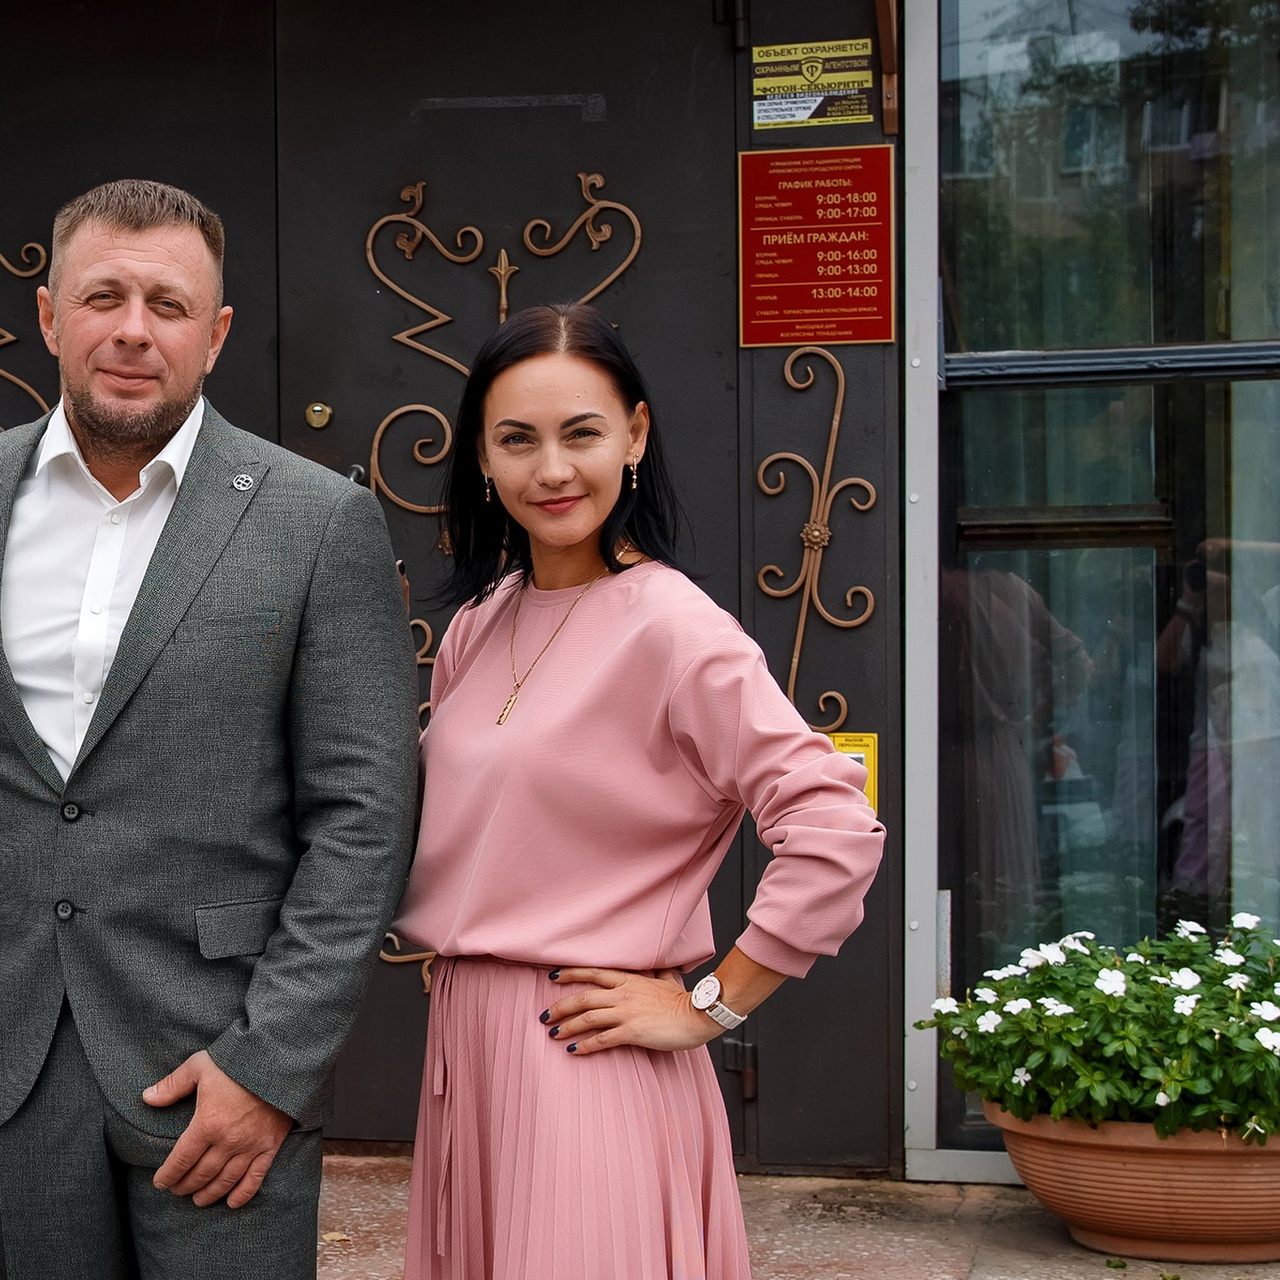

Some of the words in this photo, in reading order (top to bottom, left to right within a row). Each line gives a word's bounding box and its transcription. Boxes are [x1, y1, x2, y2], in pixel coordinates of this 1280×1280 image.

[757, 48, 798, 58] ОБЪЕКТ
[801, 42, 869, 55] ОХРАНЯЕТСЯ
[755, 64, 800, 75] ОХРАННЫМ
[824, 59, 868, 70] АГЕНТСТВОМ
[778, 180, 813, 190] ГРАФИК
[815, 178, 852, 188] РАБОТЫ:
[816, 192, 877, 205] 9:00-18:00
[816, 206, 877, 219] 9:00-17:00
[763, 232, 804, 245] ПРИЁМ
[807, 231, 869, 243] ГРАЖДАН:
[817, 249, 877, 261] 9:00-16:00
[817, 264, 877, 276] 9:00-13:00
[811, 286, 878, 299] 13:00-14:00
